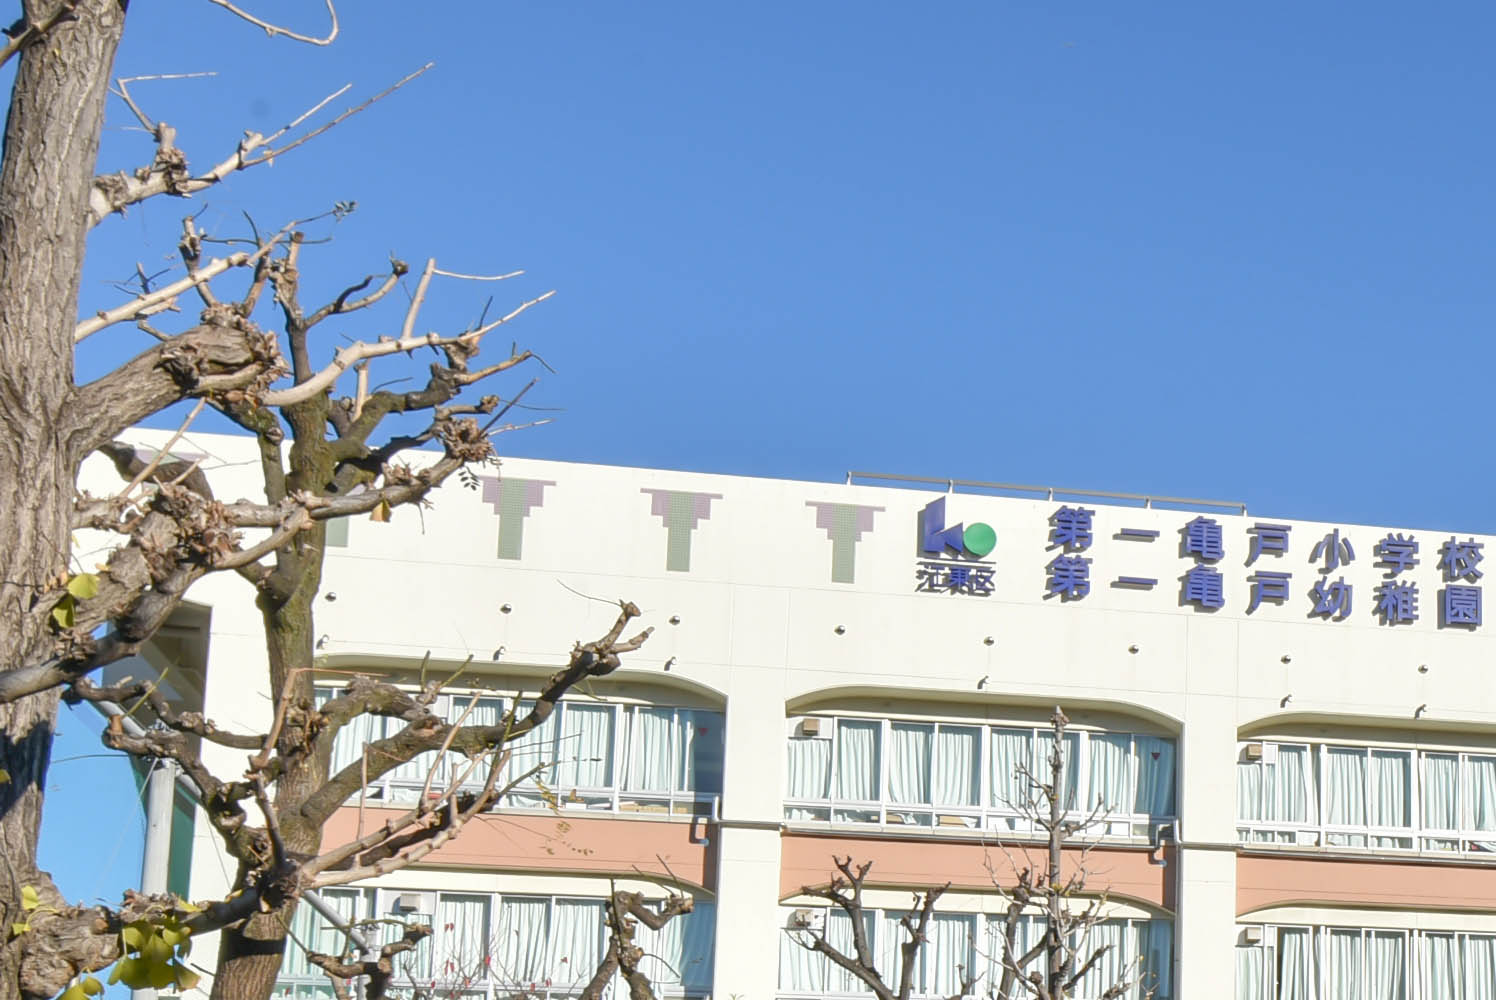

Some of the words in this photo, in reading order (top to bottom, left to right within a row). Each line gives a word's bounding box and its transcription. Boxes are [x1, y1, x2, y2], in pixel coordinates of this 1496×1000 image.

[922, 562, 997, 593] 江東区
[1050, 505, 1485, 581] 第一亀戸小学校
[1048, 554, 1483, 630] 第一亀戸幼稚園
